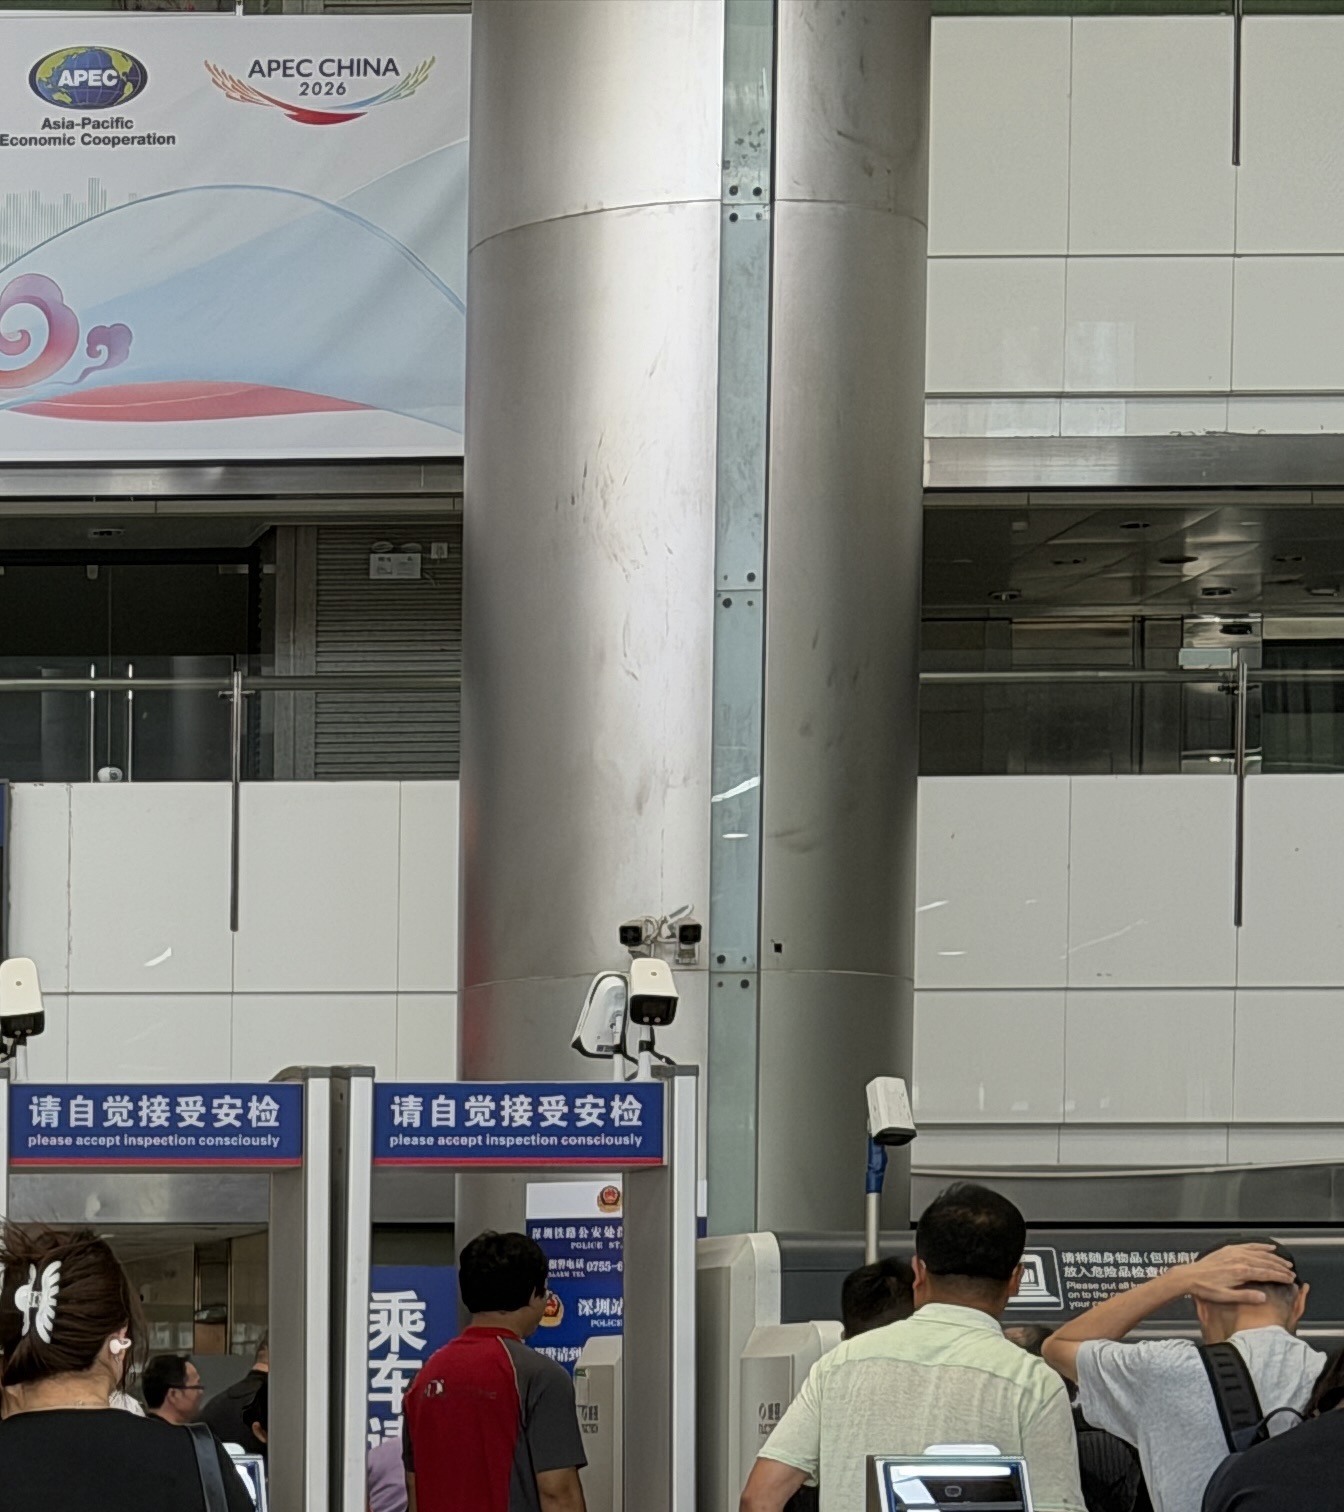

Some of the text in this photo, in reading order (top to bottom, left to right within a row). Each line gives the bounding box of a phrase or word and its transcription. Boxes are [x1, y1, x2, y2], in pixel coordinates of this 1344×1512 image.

[248, 57, 401, 79] APEC CHINA
[58, 68, 118, 88] APEC
[299, 81, 348, 97] 2026
[41, 117, 134, 131] Asia-Pacific
[0, 133, 176, 149] Economic Cooperation
[29, 1094, 280, 1129] 请自觉接受安检
[390, 1094, 642, 1129] 请自觉接受安检
[28, 1133, 280, 1149] please accept inspection consciously
[390, 1133, 642, 1150] please accept inspection consciously
